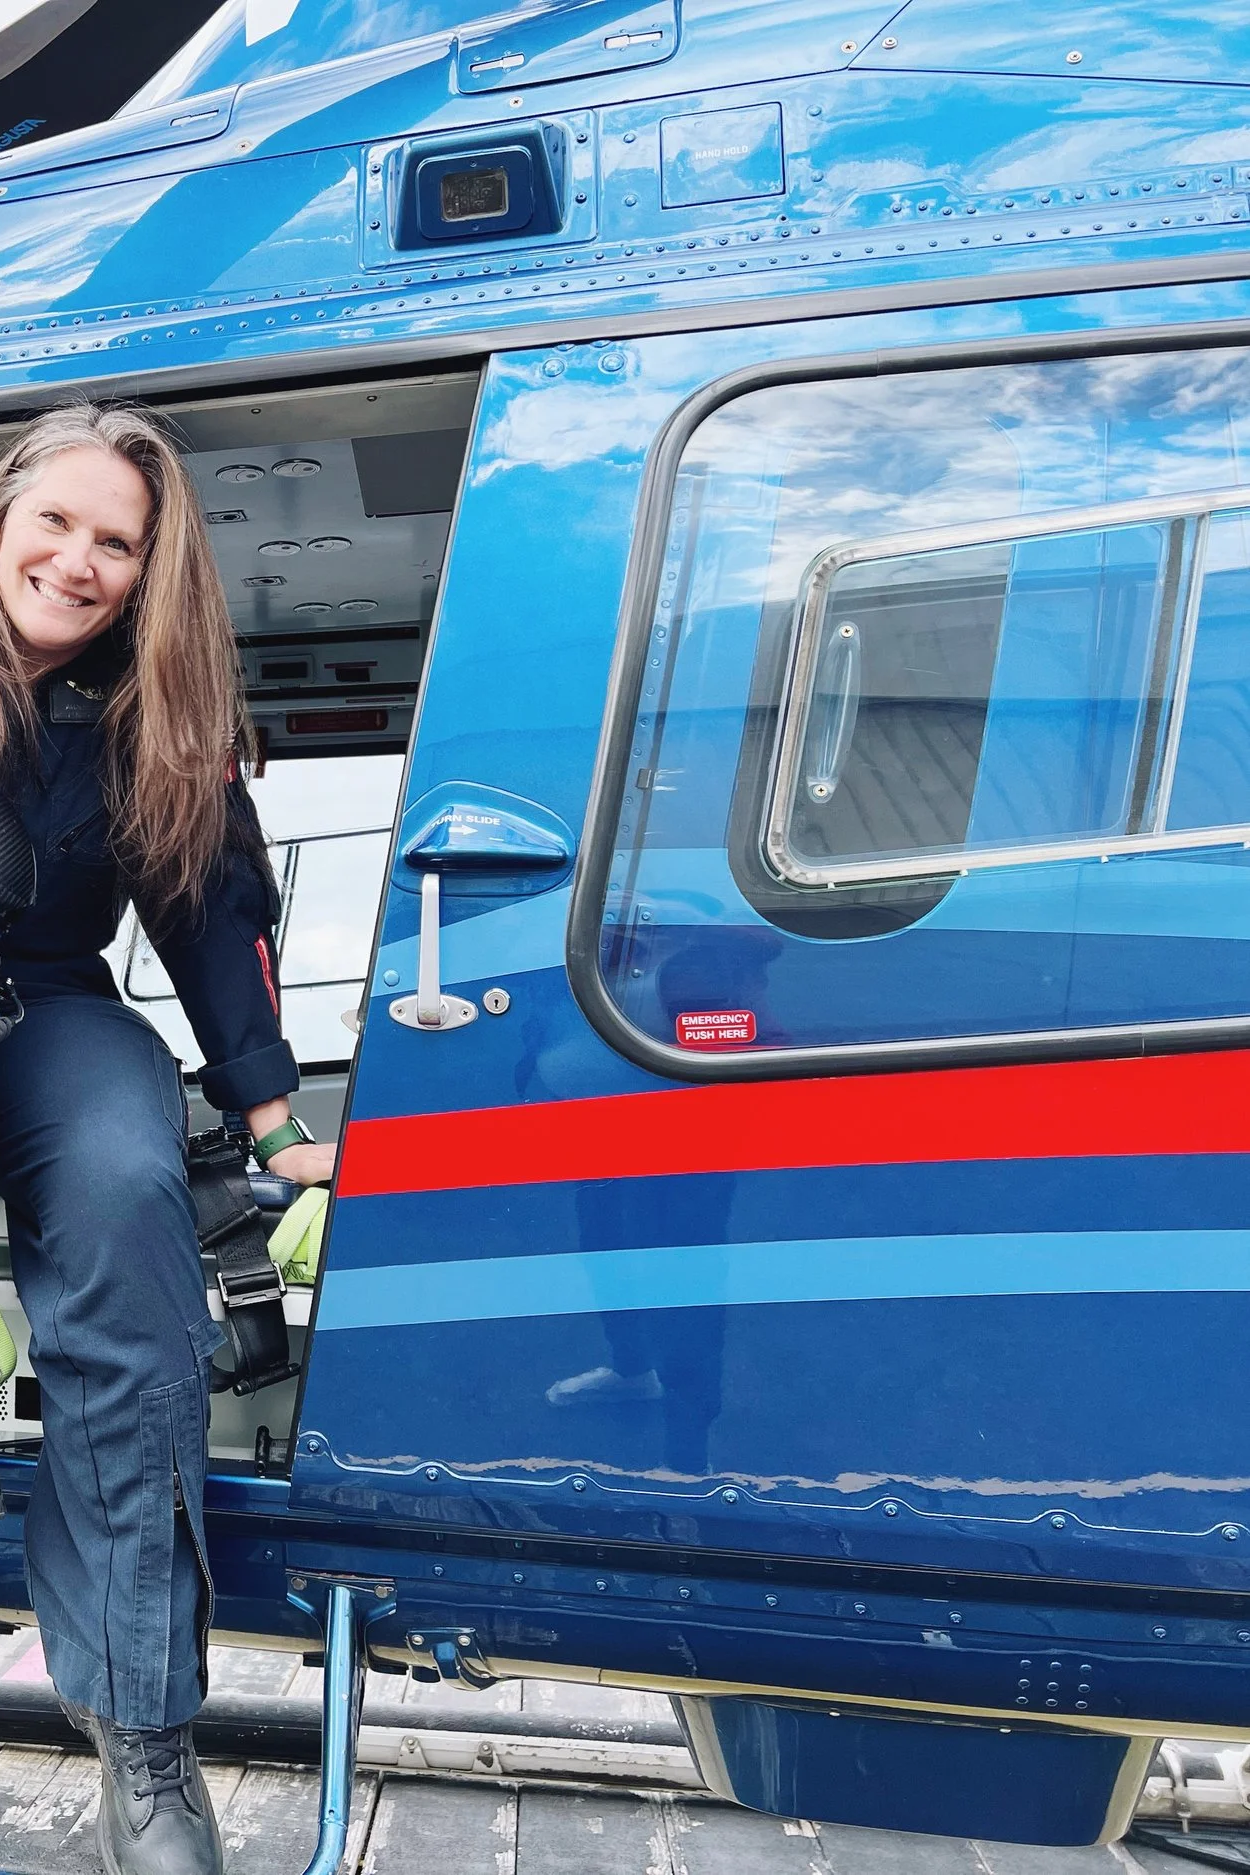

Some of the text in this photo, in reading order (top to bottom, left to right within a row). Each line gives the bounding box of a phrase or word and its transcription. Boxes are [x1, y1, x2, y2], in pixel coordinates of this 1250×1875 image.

[695, 145, 748, 160] HAND HOLD
[465, 815, 501, 826] SLIDE
[681, 1014, 749, 1025] EMERGENCY
[685, 1029, 748, 1040] PUSH HERE
